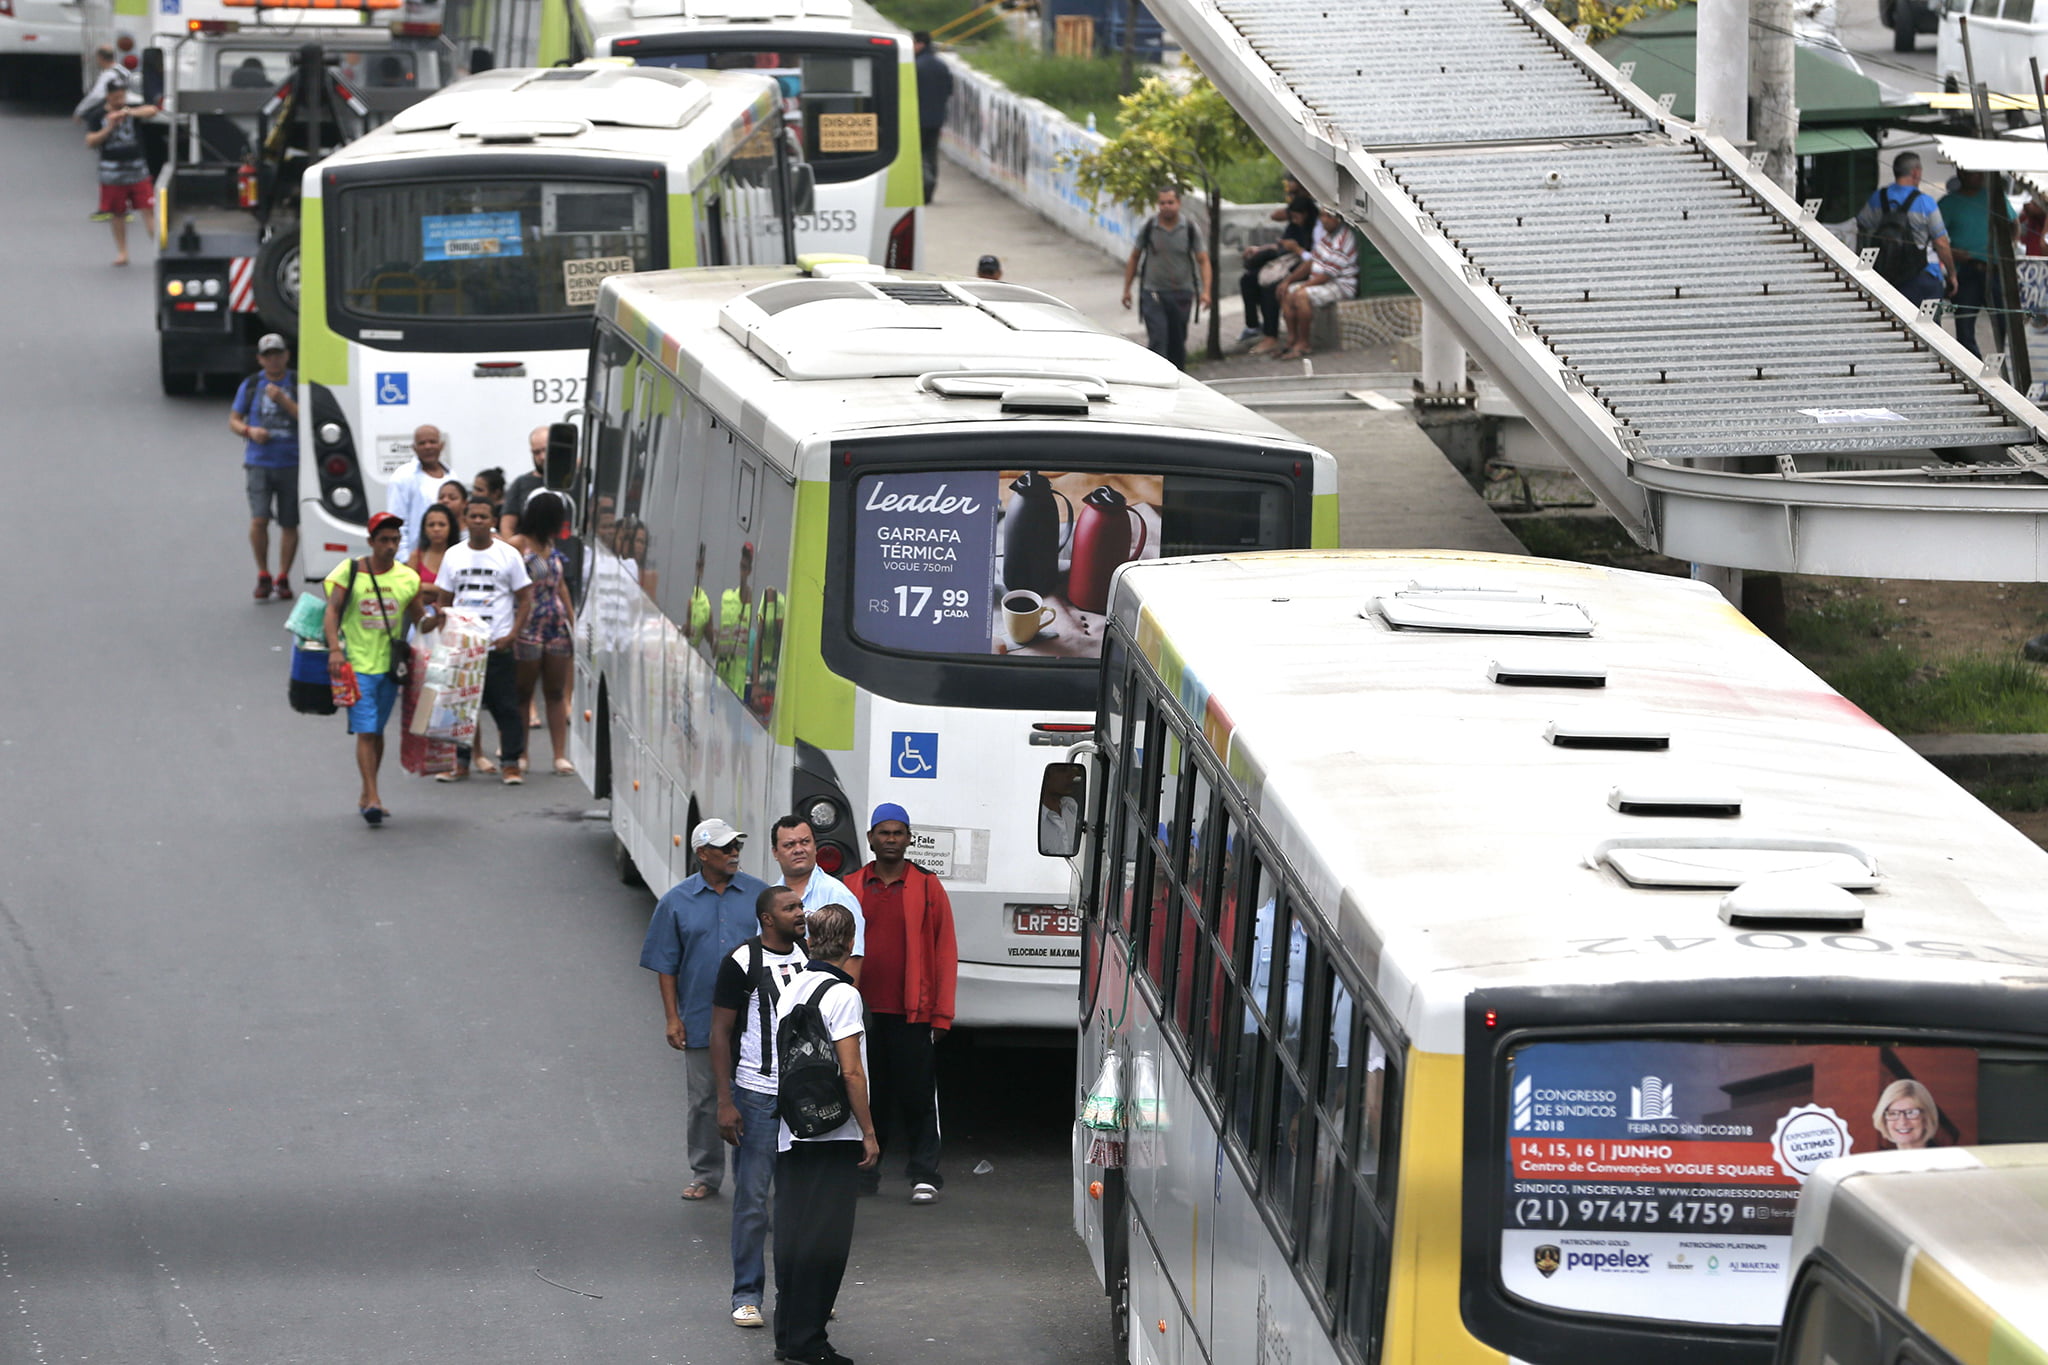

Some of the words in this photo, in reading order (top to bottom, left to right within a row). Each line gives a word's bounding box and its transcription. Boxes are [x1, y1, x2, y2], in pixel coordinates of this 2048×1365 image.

[823, 117, 873, 127] DISQUE
[793, 209, 857, 233] 51553
[567, 260, 630, 275] DISQUE
[865, 481, 981, 515] Leader
[877, 526, 962, 544] GARRAFA
[880, 541, 958, 561] TÉRMICA
[883, 561, 920, 572] VOGUE
[922, 562, 954, 573] 750ml
[868, 598, 890, 614] R$
[943, 609, 970, 618] CADA
[917, 835, 936, 845] Fale
[928, 859, 945, 867] 1000
[1008, 947, 1048, 957] VELOCIDADE
[1534, 1089, 1617, 1103] CONGRESSO
[1534, 1104, 1553, 1116] DE
[1555, 1103, 1617, 1118] SÍNDICOS
[1534, 1119, 1565, 1132] 2018
[1628, 1123, 1658, 1134] FEIRA
[1660, 1124, 1679, 1134] DO
[1520, 1142, 1543, 1158] 14,
[1549, 1143, 1571, 1159] 15,
[1577, 1144, 1595, 1158] 16
[1611, 1145, 1673, 1161] JUNHO
[1790, 1138, 1836, 1153] ÚLTIMAS
[1520, 1160, 1566, 1172] Centro
[1567, 1162, 1585, 1173] de
[1586, 1161, 1662, 1176] Convenções
[1664, 1163, 1715, 1175] VOGUE
[1717, 1165, 1775, 1178] SQUARE
[1514, 1182, 1570, 1195] SÍNDICO,
[1572, 1184, 1655, 1196] INSCREVA-SE!
[1516, 1199, 1569, 1227] (21)
[1579, 1200, 1660, 1224] 97475
[1668, 1202, 1735, 1225] 4759
[1567, 1248, 1651, 1272] papelex
